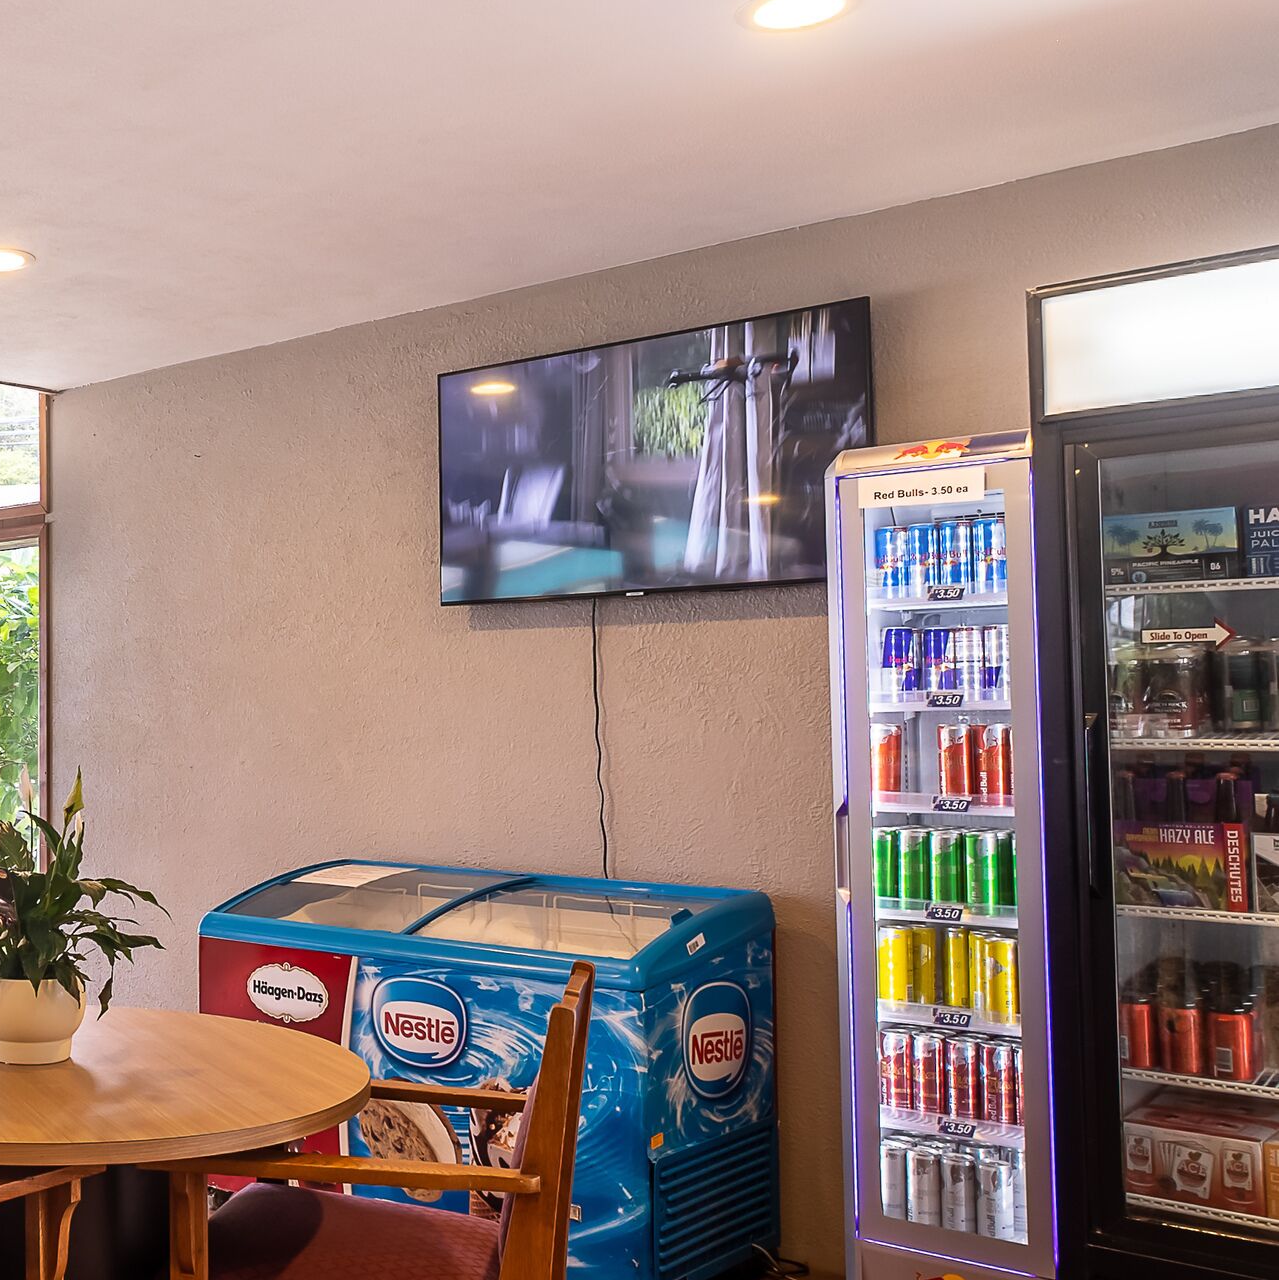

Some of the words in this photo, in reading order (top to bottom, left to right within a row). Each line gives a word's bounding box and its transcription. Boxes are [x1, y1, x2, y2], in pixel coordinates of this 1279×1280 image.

[873, 491, 895, 500] Red
[897, 488, 929, 498] Bulls-
[931, 485, 953, 496] 3.50
[1149, 632, 1171, 641] Slide
[1173, 632, 1183, 640] To
[1184, 631, 1208, 640] Open
[1159, 828, 1191, 844] HAZY
[1194, 829, 1215, 845] ALE
[1226, 830, 1243, 903] DESCHUTES
[384, 1010, 455, 1045] Nestlé
[691, 1029, 744, 1065] Nestlé
[1178, 1160, 1208, 1177] ACE
